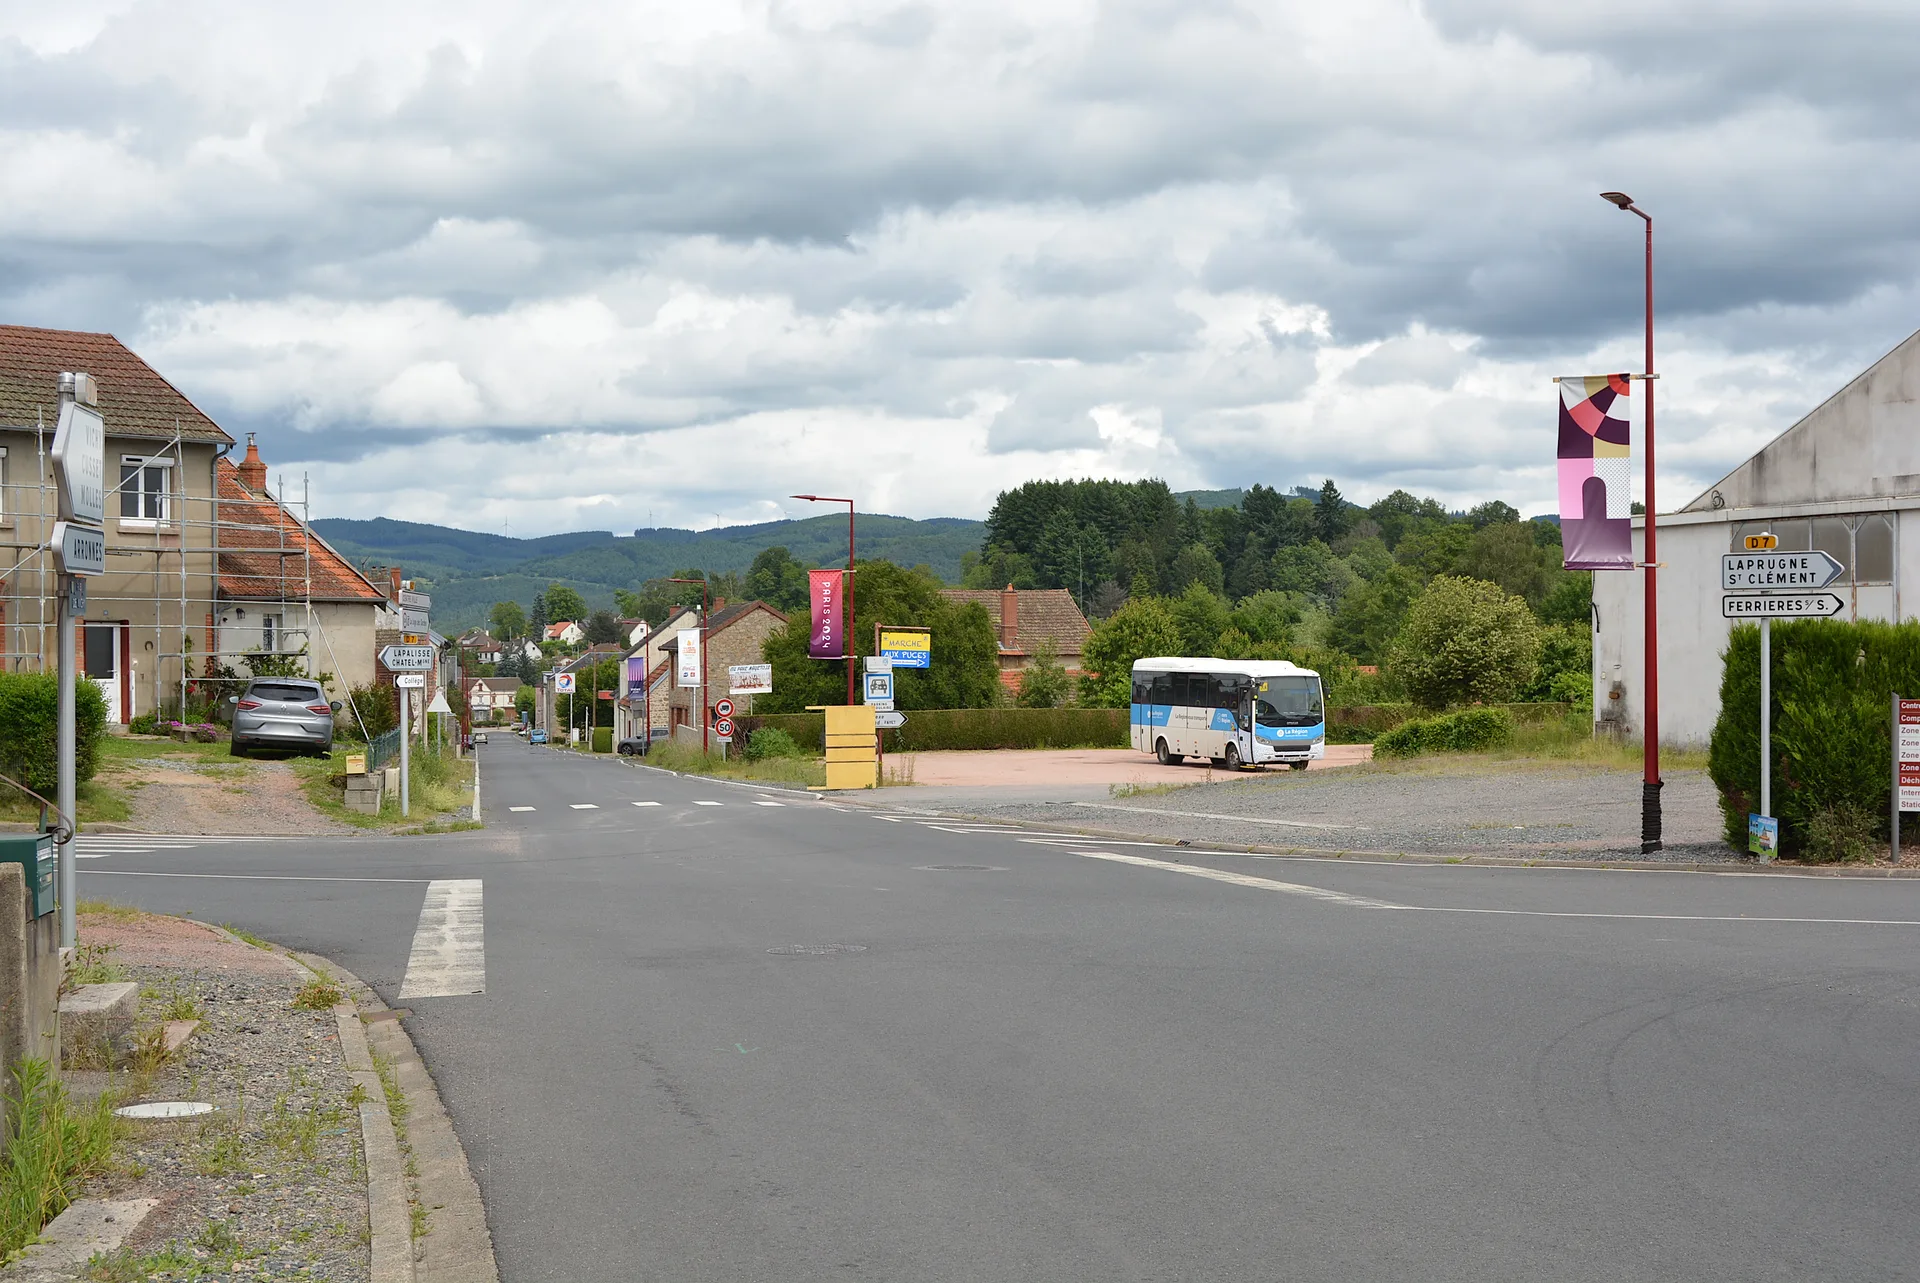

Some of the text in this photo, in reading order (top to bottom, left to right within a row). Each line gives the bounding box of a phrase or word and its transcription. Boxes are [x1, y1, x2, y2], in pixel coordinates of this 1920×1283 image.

[82, 454, 102, 480] CUSSET
[80, 484, 102, 510] MOLLES
[1751, 537, 1770, 548] D 7
[74, 538, 102, 562] ARRONNES
[1729, 558, 1808, 571] LAPRUGNE
[1748, 571, 1816, 584] CLÉMENT
[1729, 600, 1803, 612] FERRIERES
[822, 581, 831, 649] PARIS 2024
[889, 640, 923, 648] MARCHE
[393, 649, 431, 658] LAPALISSE
[884, 650, 927, 660] AUX PUCES
[719, 723, 731, 732] 50
[1901, 751, 1919, 759] Zone
[1901, 763, 1919, 771] Zone
[1901, 776, 1920, 784] Déch
